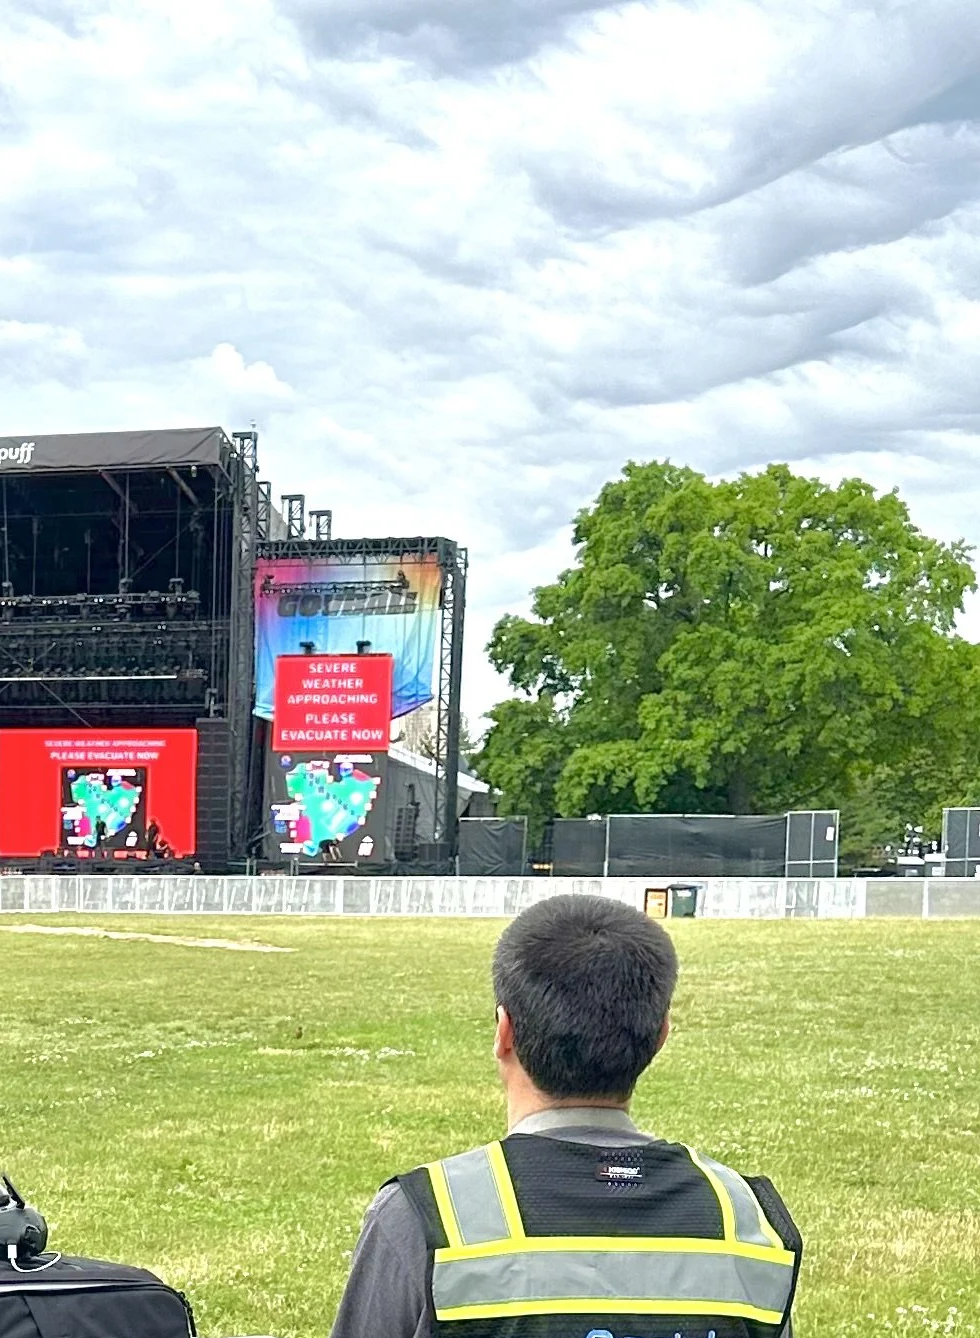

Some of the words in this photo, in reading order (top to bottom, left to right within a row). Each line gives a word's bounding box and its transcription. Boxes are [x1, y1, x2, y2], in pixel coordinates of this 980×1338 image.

[309, 663, 357, 673] SEVERE
[302, 678, 364, 689] WEATHER
[287, 694, 378, 704] APPROACHING
[305, 713, 356, 724] PLEASE
[281, 730, 348, 741] EVACUATE
[352, 729, 383, 740] NOW
[50, 752, 85, 760] PLEASE
[87, 752, 134, 760] EVACUATE
[137, 752, 159, 760] NOW
